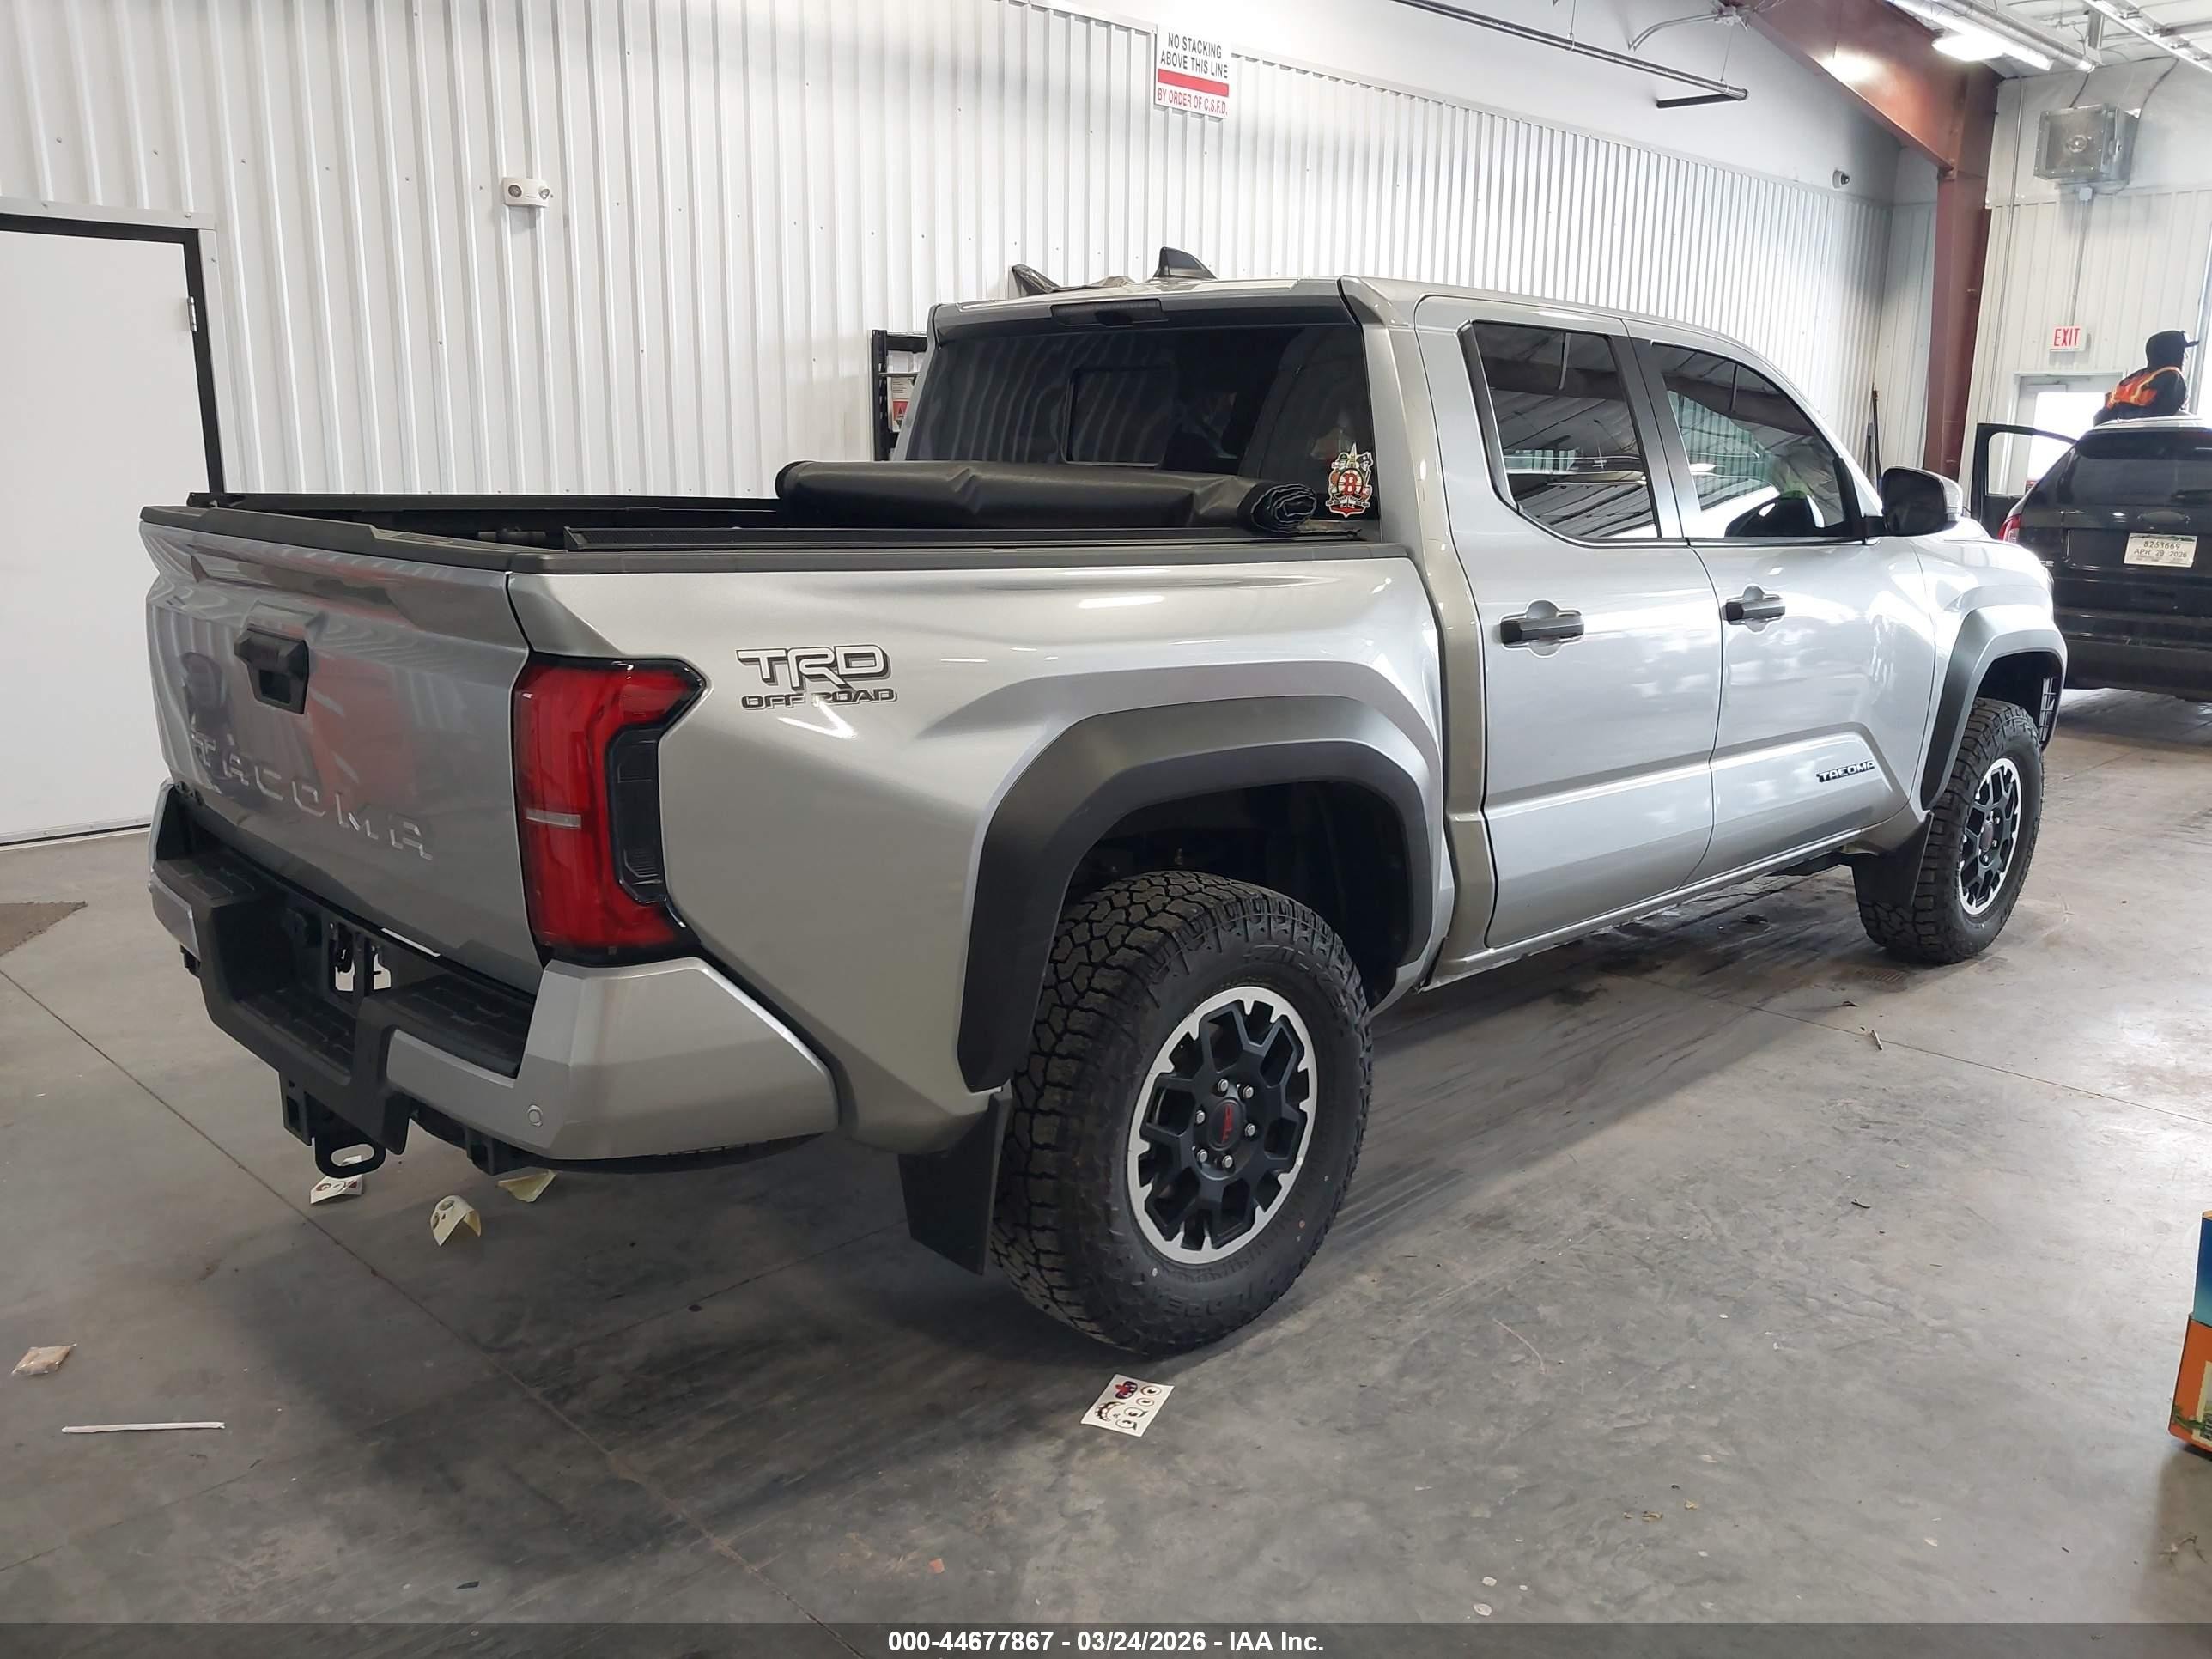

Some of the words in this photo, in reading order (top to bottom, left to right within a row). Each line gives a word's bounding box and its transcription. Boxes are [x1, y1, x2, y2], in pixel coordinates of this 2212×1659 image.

[1168, 32, 1180, 49] NO
[1182, 36, 1222, 59] STACKING
[1160, 49, 1188, 70] ABOVE
[1190, 57, 1209, 75] THIS
[1211, 61, 1228, 79] LINE
[1158, 88, 1167, 102] BY
[1168, 89, 1192, 107] ORDER
[1193, 95, 1202, 110] OF
[2053, 327, 2081, 347] EXIT
[736, 644, 891, 692] TRD
[741, 693, 805, 709] OFF
[1815, 760, 1875, 783] TACOMA
[191, 730, 434, 860] TACOMA
